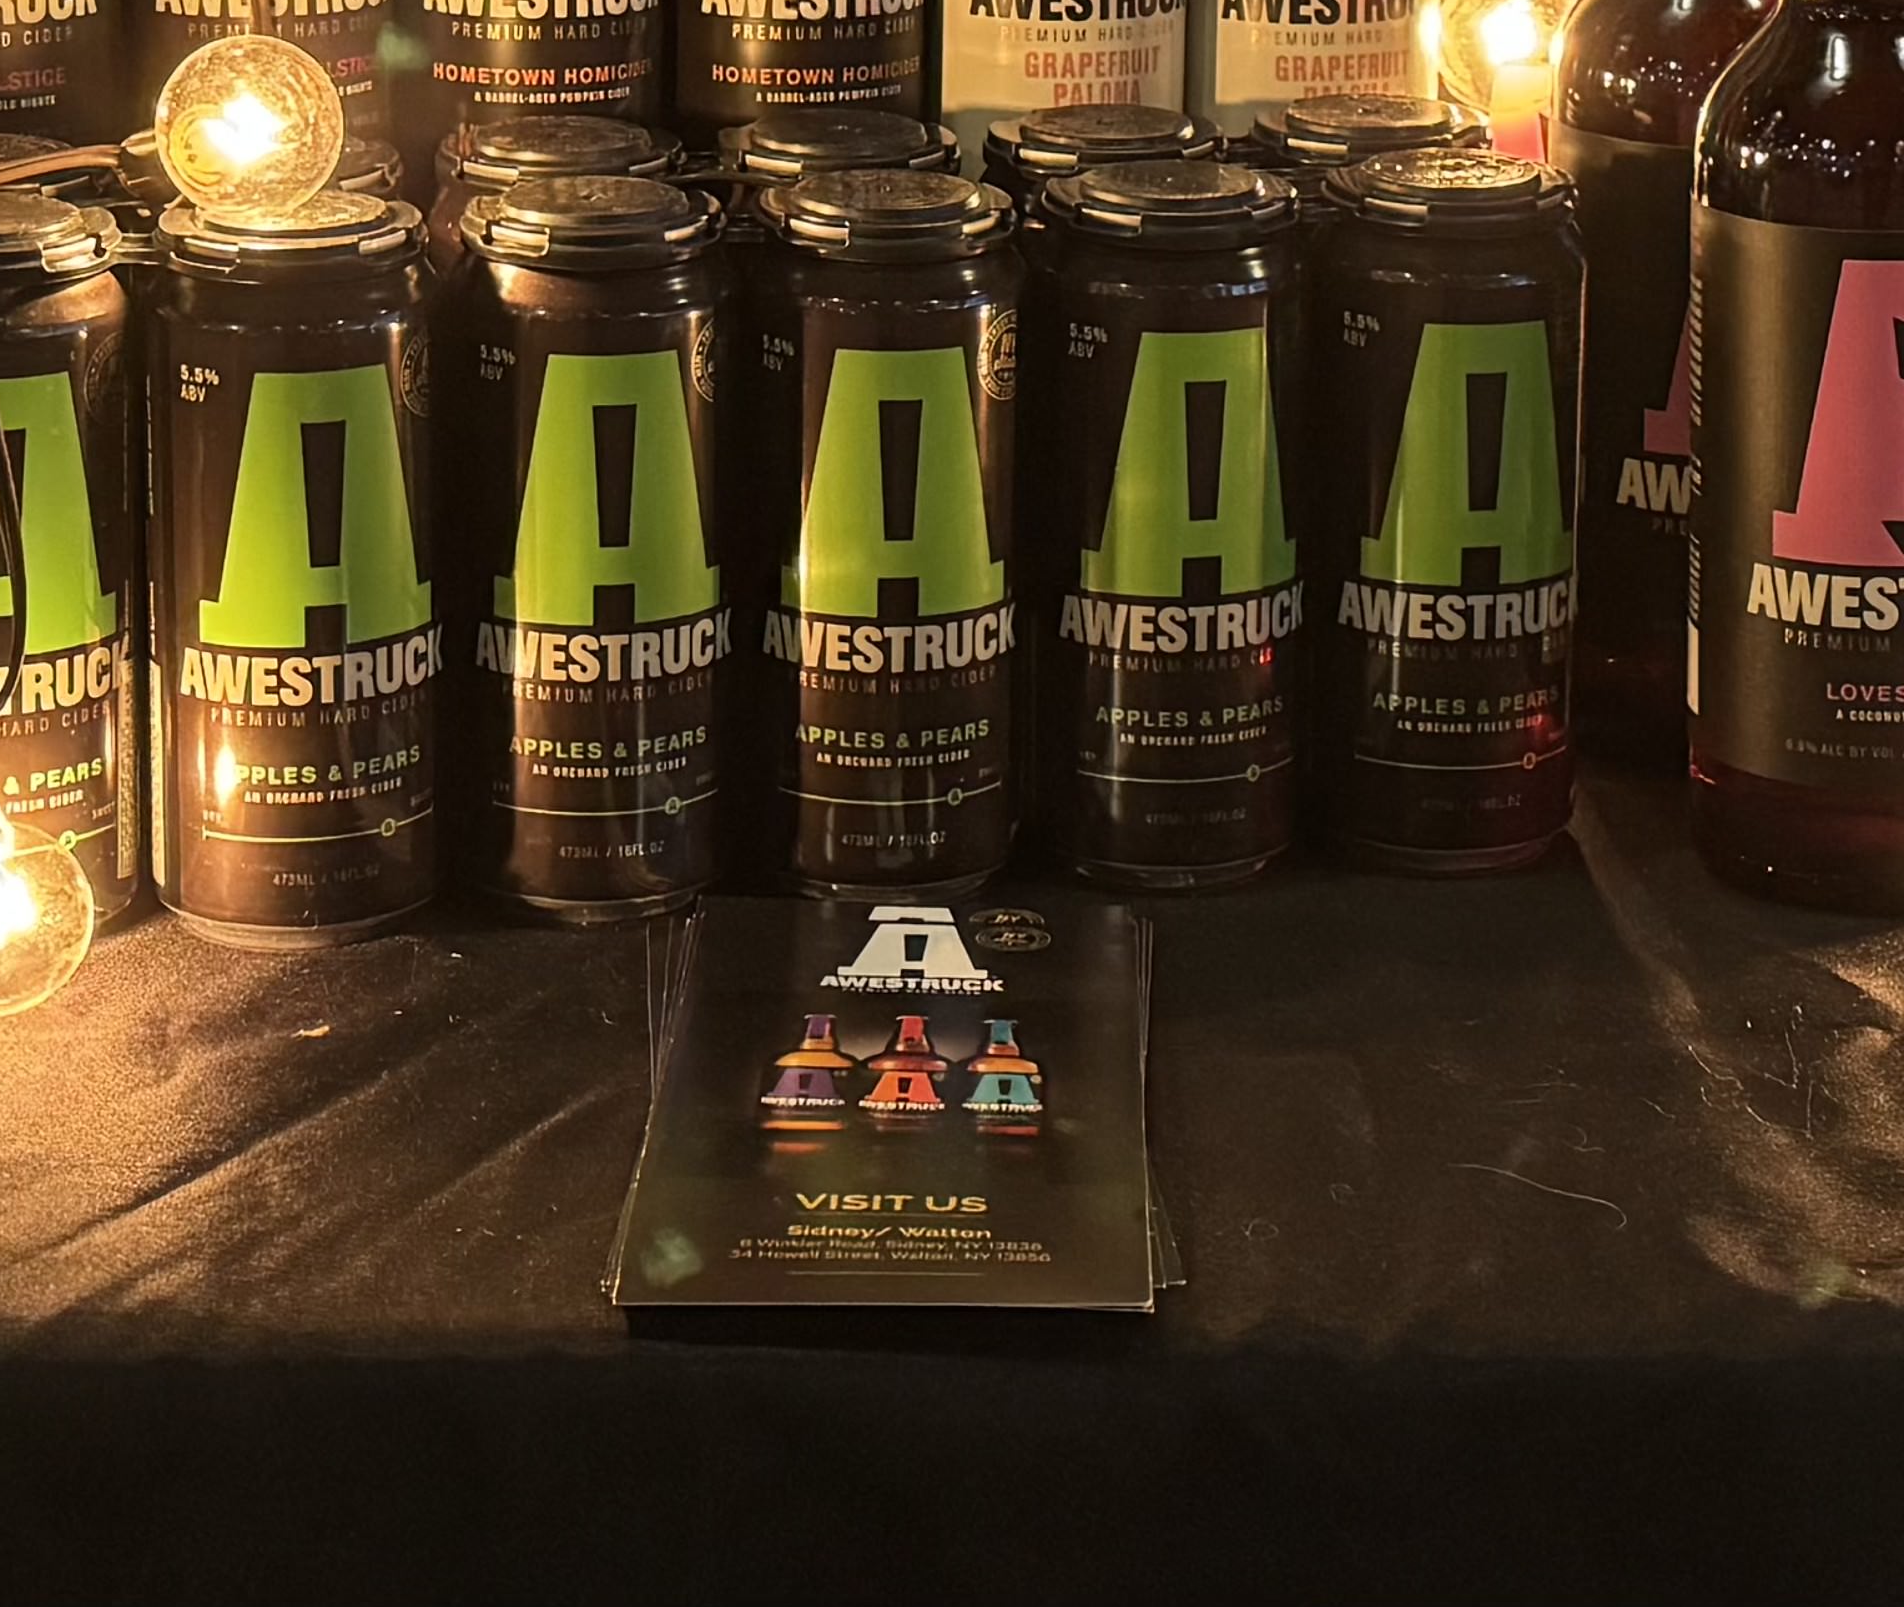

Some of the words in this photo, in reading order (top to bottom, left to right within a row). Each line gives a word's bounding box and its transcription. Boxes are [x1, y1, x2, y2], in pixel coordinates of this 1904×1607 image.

[433, 62, 555, 85] HOMETOWN
[565, 59, 652, 85] HOMICIDER
[712, 64, 834, 84] HOMETOWN
[843, 56, 920, 83] HOMICIDER
[1024, 47, 1160, 78] GRAPEFRUIT
[1276, 50, 1407, 81] GRAPEFRUIT
[1069, 323, 1108, 343] 5.5%
[1343, 311, 1380, 333] 5.5%
[1068, 340, 1096, 359] ABV
[180, 364, 220, 385] 5.5%
[180, 384, 205, 403] ABV
[1060, 580, 1304, 653] AWESTRUCK
[1338, 570, 1579, 641] AWESTRUCK
[476, 608, 732, 682] AWESTRUCK
[763, 603, 1016, 673] AWESTRUCK
[1785, 628, 1890, 652] PREMIUM
[180, 623, 443, 706] AWESTRUCK
[1096, 706, 1188, 728] APPLES
[1200, 711, 1212, 726] &
[1223, 696, 1283, 724] PEARS
[1374, 694, 1466, 715] APPLES
[1477, 699, 1489, 715] &
[1499, 686, 1558, 713] PEARS
[1836, 708, 1843, 720] A
[62, 703, 110, 727] CIDER
[509, 737, 602, 759] APPLES
[614, 743, 627, 758] &
[638, 726, 706, 756] PEARS
[796, 723, 885, 749] APPLES
[896, 733, 909, 748] &
[921, 719, 989, 746] PEARS
[3, 776, 19, 795] &
[30, 758, 102, 791] PEARS
[234, 764, 316, 785] PPLES
[328, 765, 342, 781] &
[353, 746, 420, 778] PEARS
[820, 976, 1004, 992] AWESTRUCK
[796, 1193, 914, 1211] VISIT
[926, 1197, 988, 1212] US
[788, 1225, 892, 1238] Sidney/
[899, 1227, 992, 1239] Walton
[955, 1242, 983, 1250] NY
[965, 1253, 990, 1261] NY
